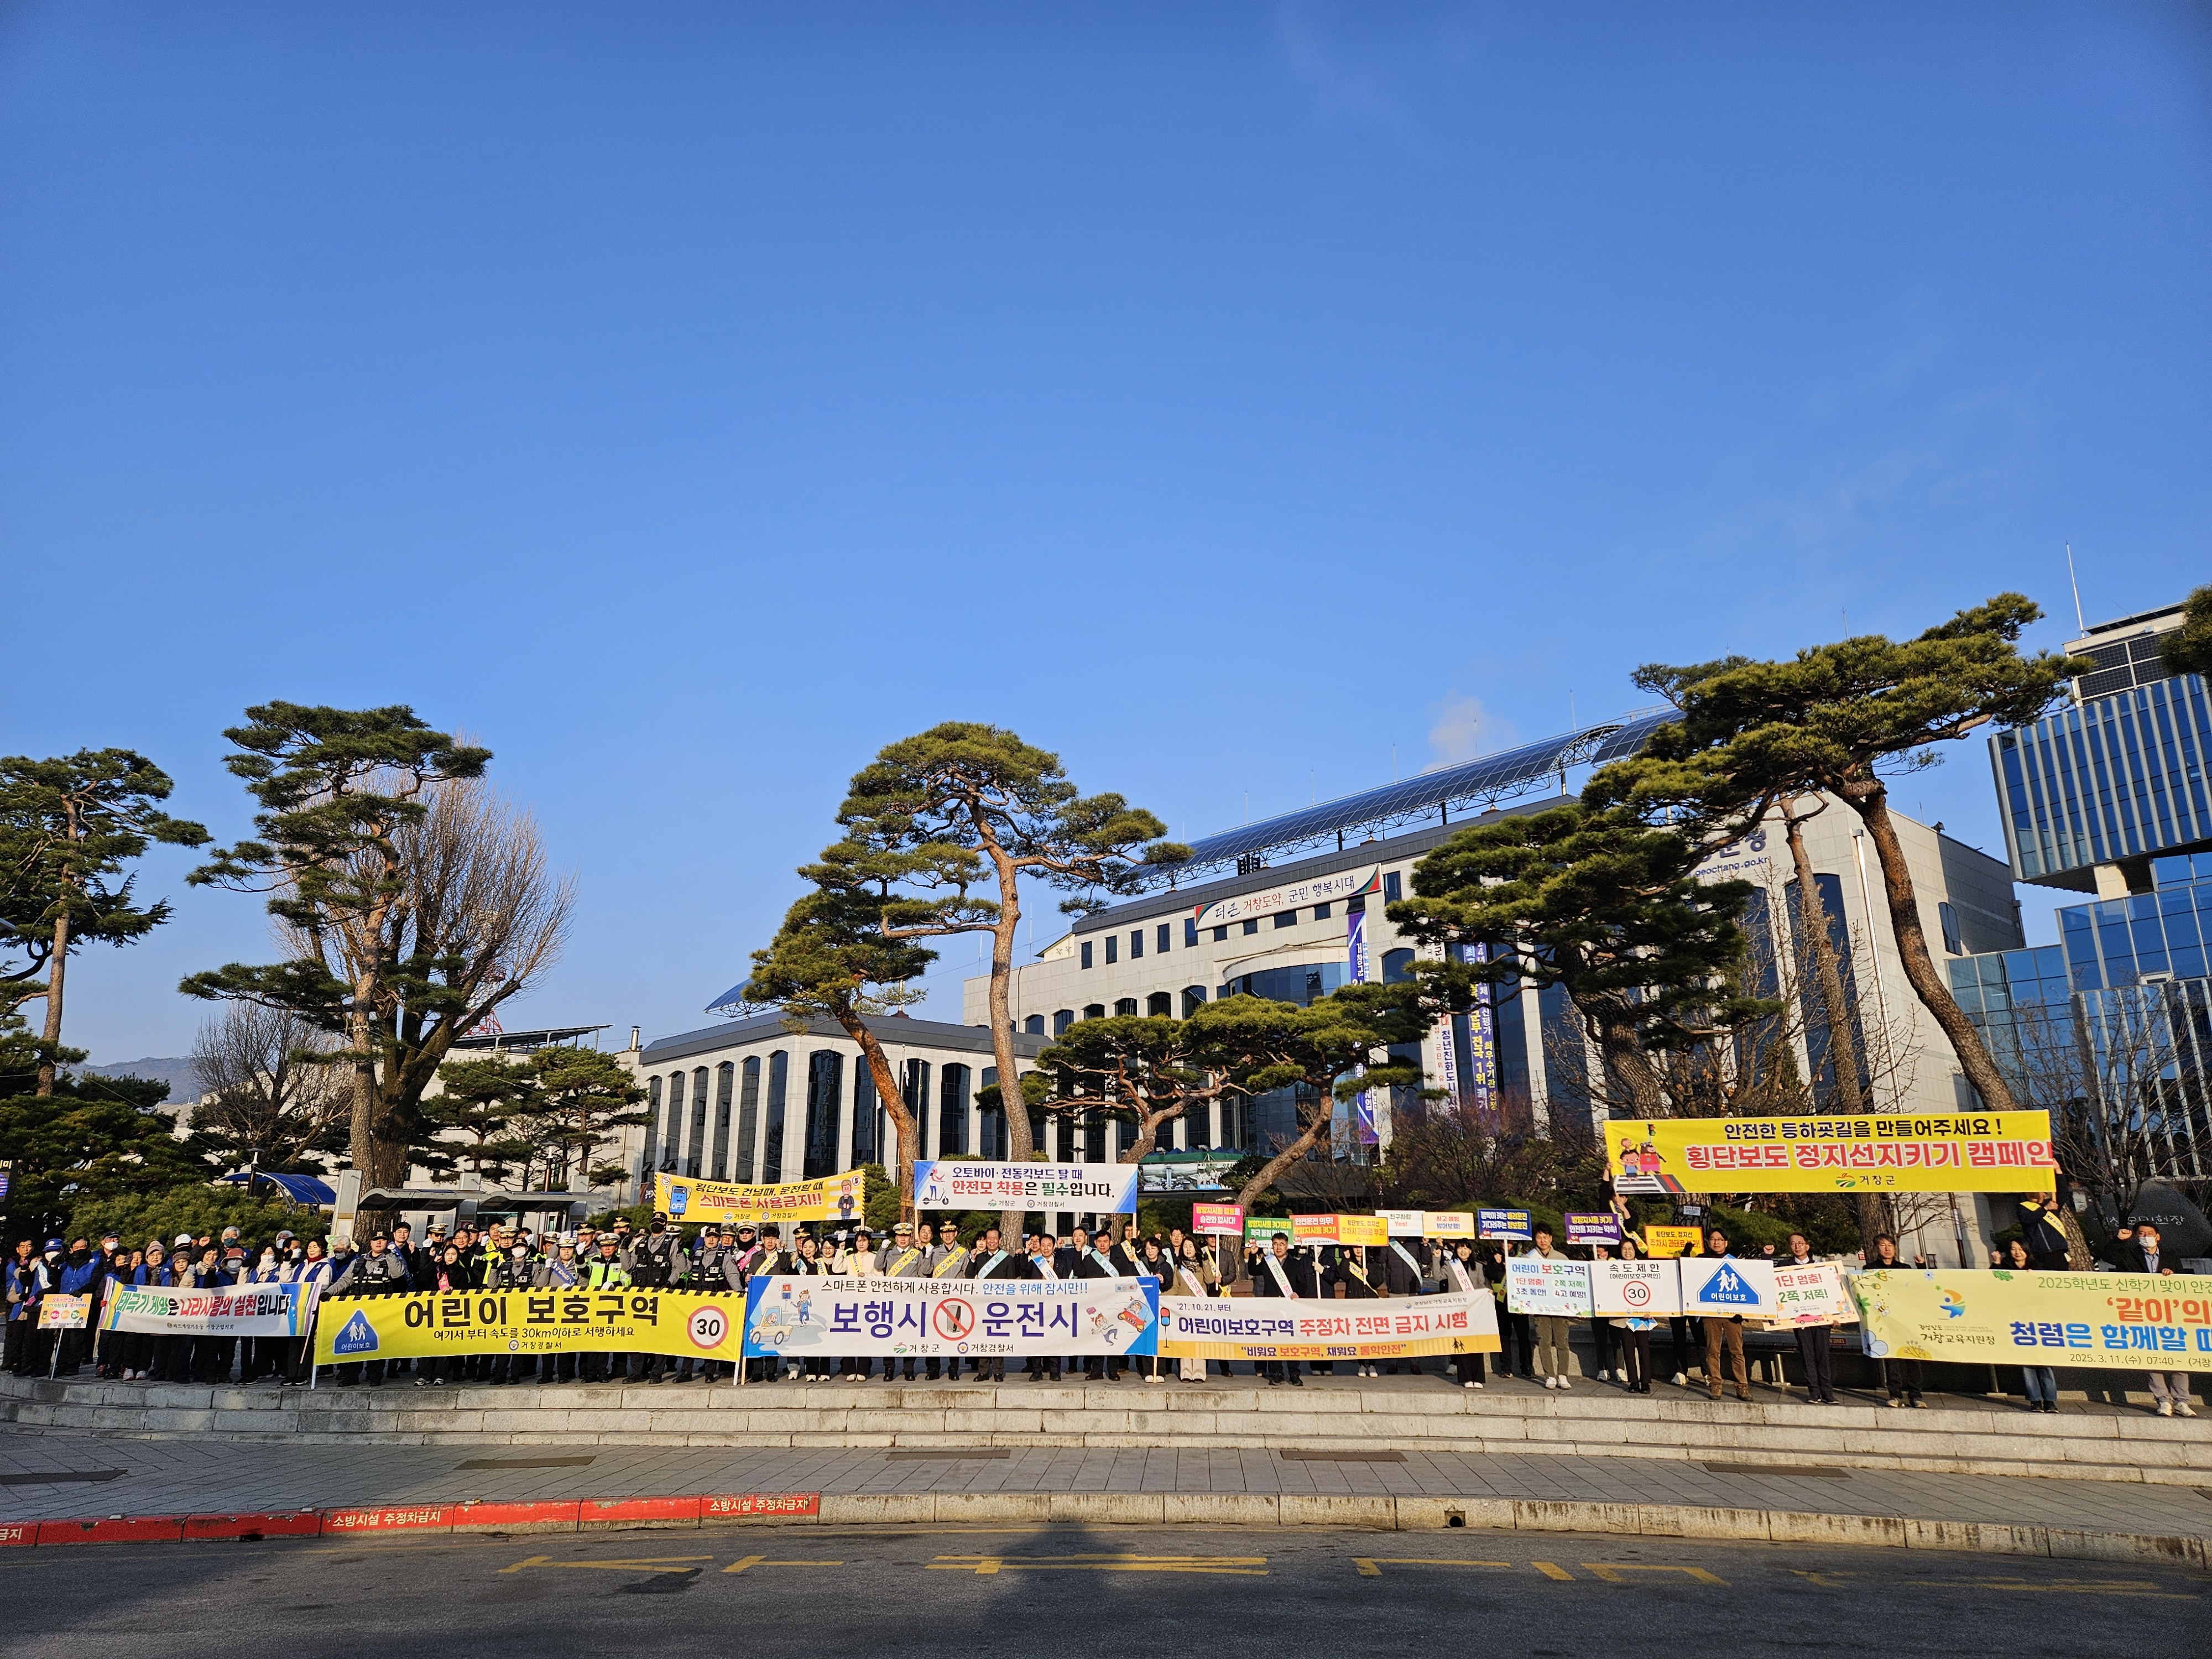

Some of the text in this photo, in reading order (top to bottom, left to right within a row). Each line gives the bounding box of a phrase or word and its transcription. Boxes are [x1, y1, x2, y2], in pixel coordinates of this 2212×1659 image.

[1215, 875, 1355, 920] 더 큰 거창도약, 군민 행복시대
[1472, 1036, 1484, 1059] 전국
[1475, 1062, 1486, 1085] 1위
[1725, 1123, 1776, 1140] 안전한
[1686, 1141, 2053, 1170] 횡단보도 정지선지키기 캠페인
[1058, 1169, 1069, 1180] 탈
[1072, 1169, 1082, 1180] 때
[1859, 1175, 1895, 1186] 거창군
[695, 1183, 739, 1195] 횡단보도
[780, 1183, 813, 1195] 운전할
[813, 1181, 824, 1191] 때
[952, 1180, 1115, 1198] 안전모 착용은 필수입니다.
[700, 1193, 822, 1209] 스마트폰 사용금지!!
[1512, 1264, 1585, 1276] 어린이 보호구역
[821, 1280, 1088, 1295] 스마트폰 안전하게 사용합시다. 안전을 위해 잠시만!!
[1775, 1274, 1823, 1287] 1단 멈춤!
[2037, 1277, 2187, 1293] 2025학년도 신학기 맞이
[1628, 1288, 1646, 1298] 30
[1711, 1292, 1747, 1301] 어린이보호
[1778, 1288, 1828, 1303] 2쪽 저쪽!
[116, 1292, 290, 1317] 태극기 게양은 나라사랑의 실천입니다
[404, 1295, 659, 1328] 어린이 보호구역
[830, 1300, 926, 1339] 보행시
[982, 1302, 1078, 1338] 운전시
[1178, 1311, 1468, 1337] 어린이보호구역 주정차 전면 금지 시행
[434, 1327, 635, 1341] 여기서 부터 속도를 30km이하로 서행하세요
[696, 1318, 721, 1337] 30
[2010, 1321, 2093, 1348] 청렴은
[2100, 1324, 2187, 1351] 함께할
[341, 1342, 371, 1350] 어린이보호
[909, 1344, 940, 1353] 거창군
[971, 1344, 1014, 1353] 거창경찰서
[1241, 1344, 1406, 1358] “비워요 보호구역, 채워요 통학안전”
[2070, 1354, 2096, 1363] 2025.
[2146, 1357, 2174, 1365] 07:40
[709, 1499, 806, 1511] 소방시설 주정차금지
[332, 1511, 441, 1527] 소방시설 주정차금지
